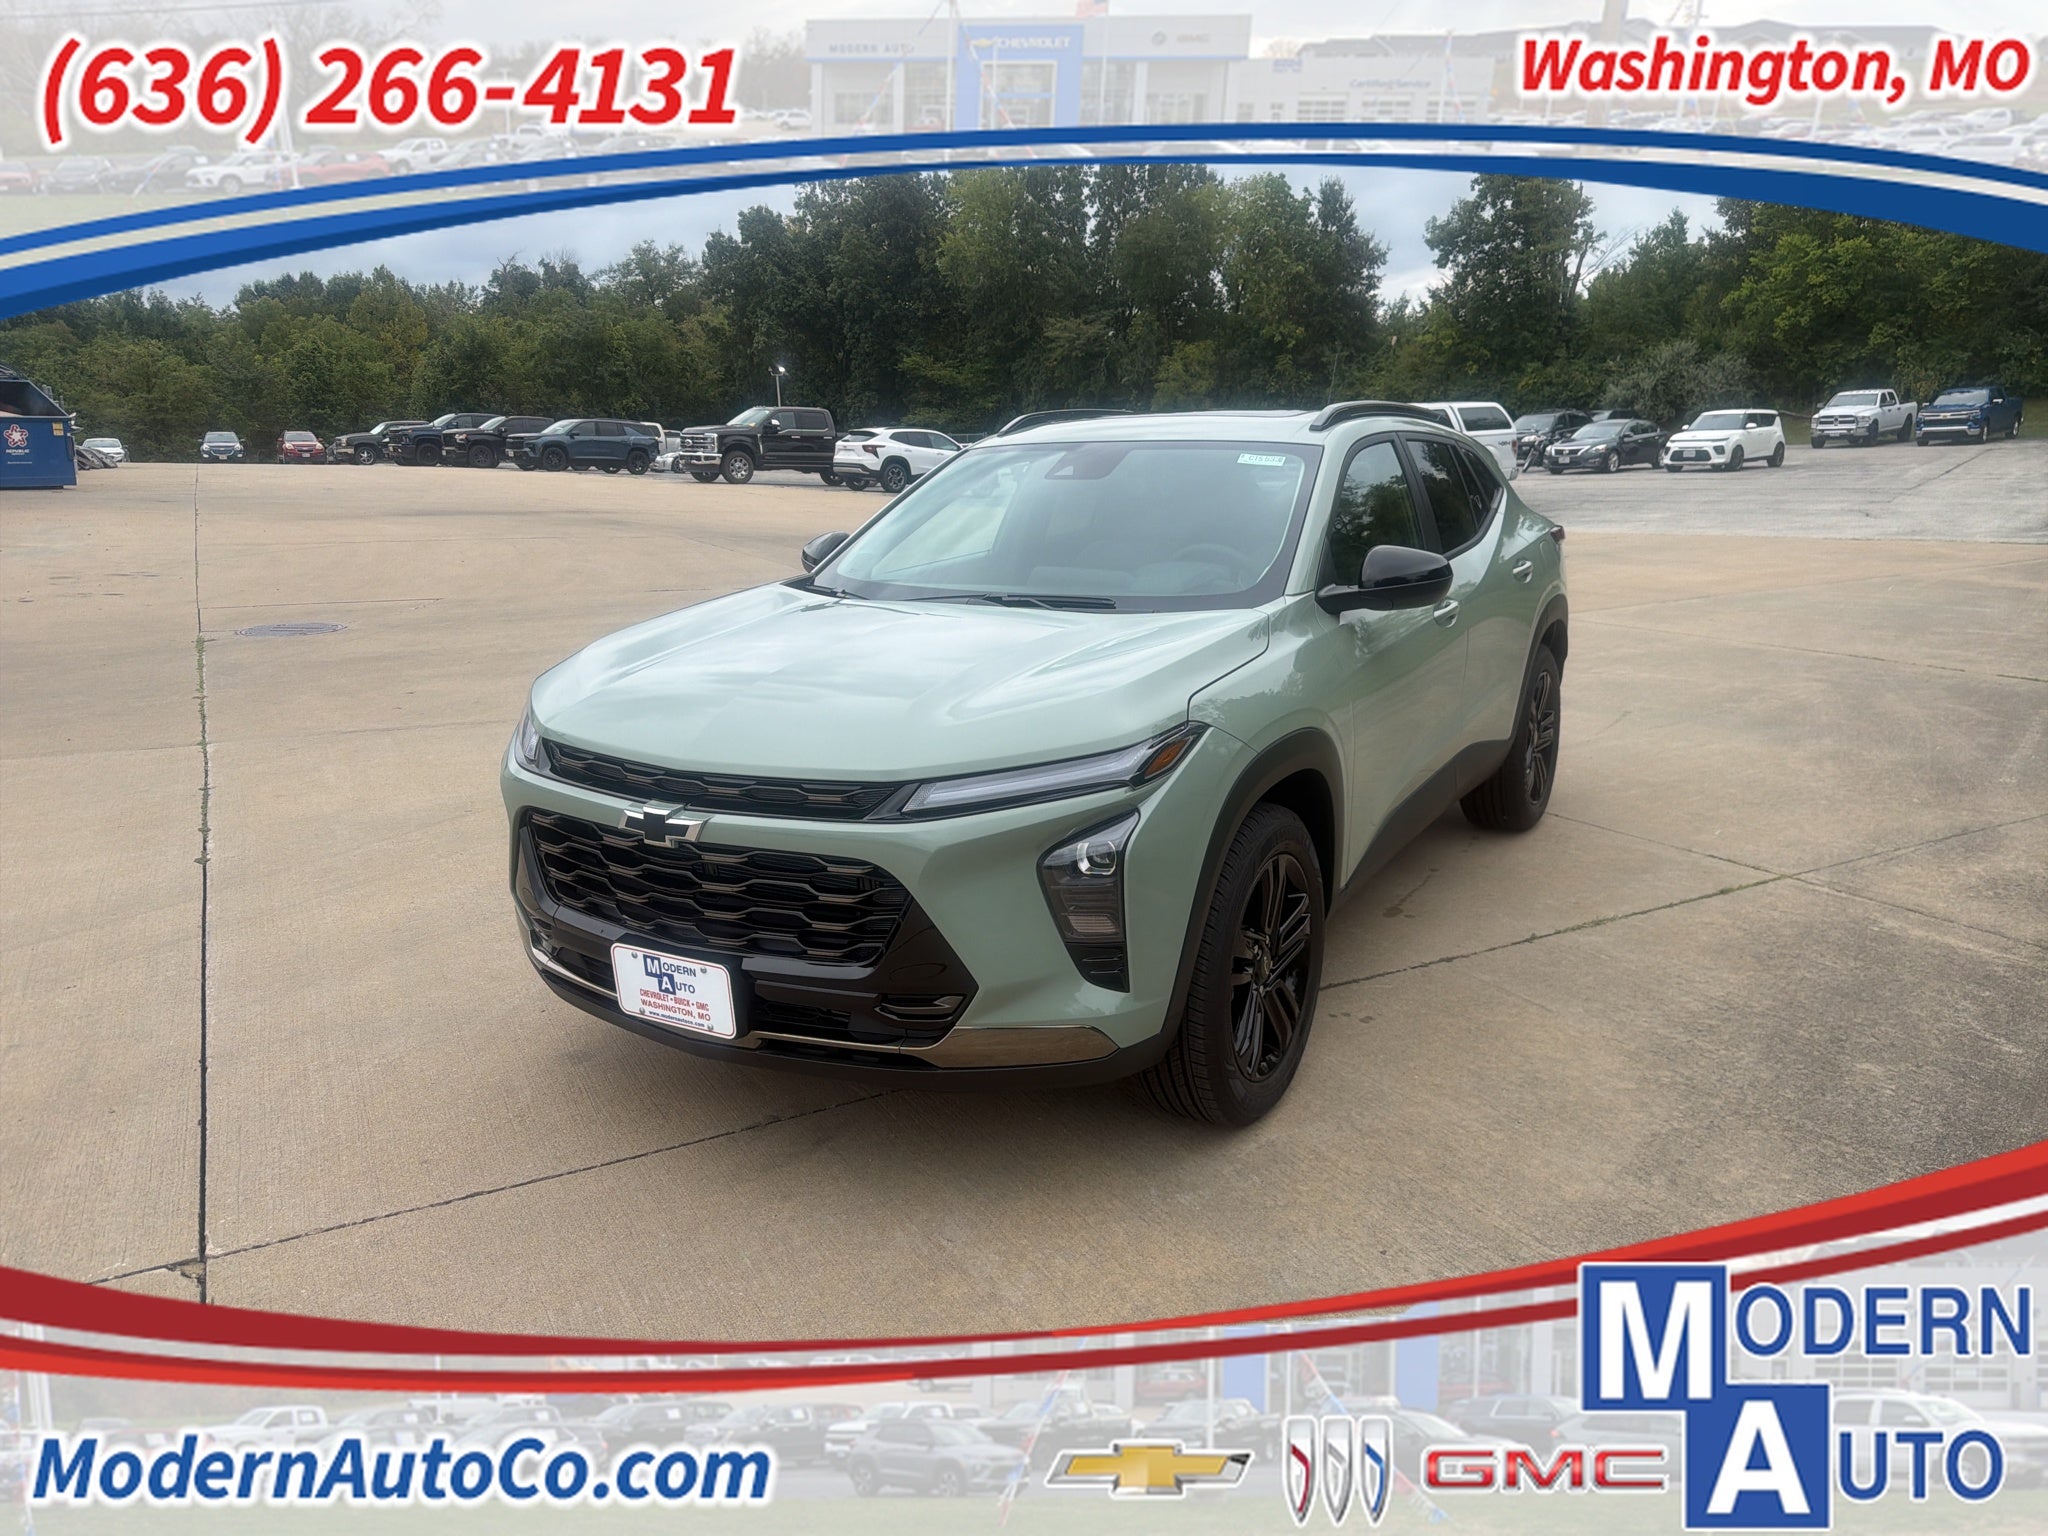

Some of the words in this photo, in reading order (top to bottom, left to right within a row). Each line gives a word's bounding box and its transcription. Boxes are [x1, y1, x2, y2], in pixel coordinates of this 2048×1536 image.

[646, 957, 697, 978] MODERN
[661, 975, 696, 994] AUTO
[640, 988, 669, 1003] CHEVROLET
[673, 996, 691, 1008] BUICK
[695, 1001, 710, 1012] GMC
[640, 998, 696, 1019] WASHINGTON,
[698, 1011, 711, 1022] MO
